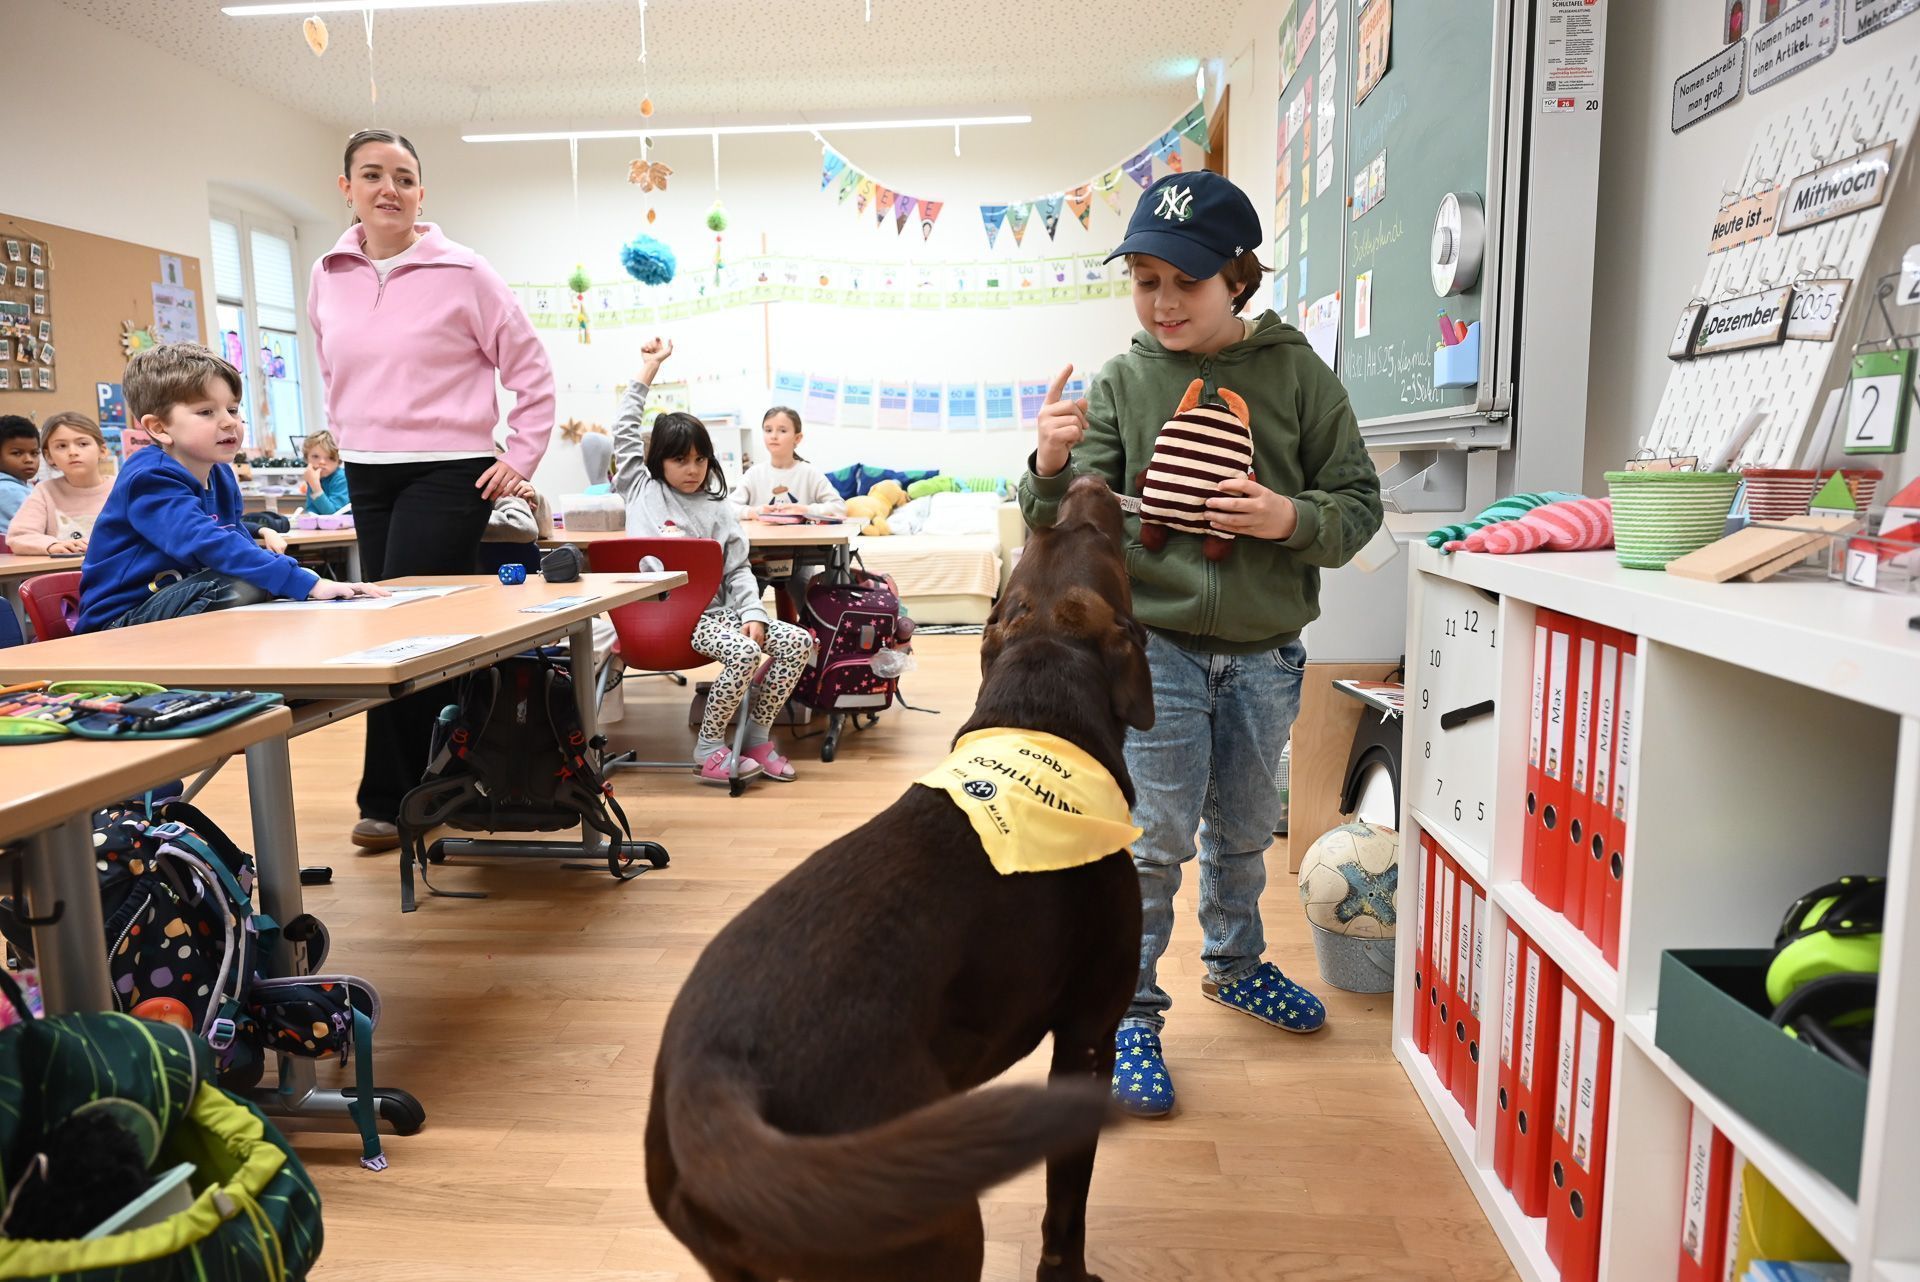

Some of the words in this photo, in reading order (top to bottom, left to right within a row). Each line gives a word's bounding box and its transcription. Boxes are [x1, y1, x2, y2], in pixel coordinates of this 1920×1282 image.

[1755, 33, 1782, 56] Nomen
[1785, 13, 1814, 36] haben
[1752, 58, 1774, 78] einen
[1775, 34, 1812, 65] Artikel.
[1679, 78, 1704, 98] Nomen
[1706, 54, 1736, 84] schreibt
[1586, 100, 1598, 110] 20
[1688, 96, 1702, 112] man
[1154, 185, 1193, 222] NY
[1711, 217, 1742, 241] Heute
[1745, 207, 1762, 228] ist
[1708, 306, 1779, 336] Dezember
[1790, 293, 1836, 320] 2025
[97, 383, 112, 408] P
[1856, 385, 1880, 440] 2
[1445, 618, 1456, 637] 11
[1464, 609, 1478, 632] 12
[1490, 629, 1496, 648] 1
[1429, 649, 1441, 668] 10
[1422, 689, 1429, 710] 9
[1551, 688, 1562, 724] Max
[1600, 698, 1610, 752] Mario
[1620, 710, 1631, 766] Emilia
[1018, 748, 1072, 779] Bobby
[1424, 741, 1431, 758] 8
[968, 755, 1084, 816] SCHULHUN
[1437, 778, 1443, 796] 7
[1454, 799, 1462, 822] 6
[1477, 801, 1484, 821] 5
[1460, 923, 1468, 961] Elijah
[1475, 928, 1483, 969] Faber
[1525, 966, 1537, 1053] Maximilian
[1561, 1041, 1571, 1089] Faber
[1581, 1077, 1592, 1109] Ella
[1691, 1144, 1706, 1213] Sophie
